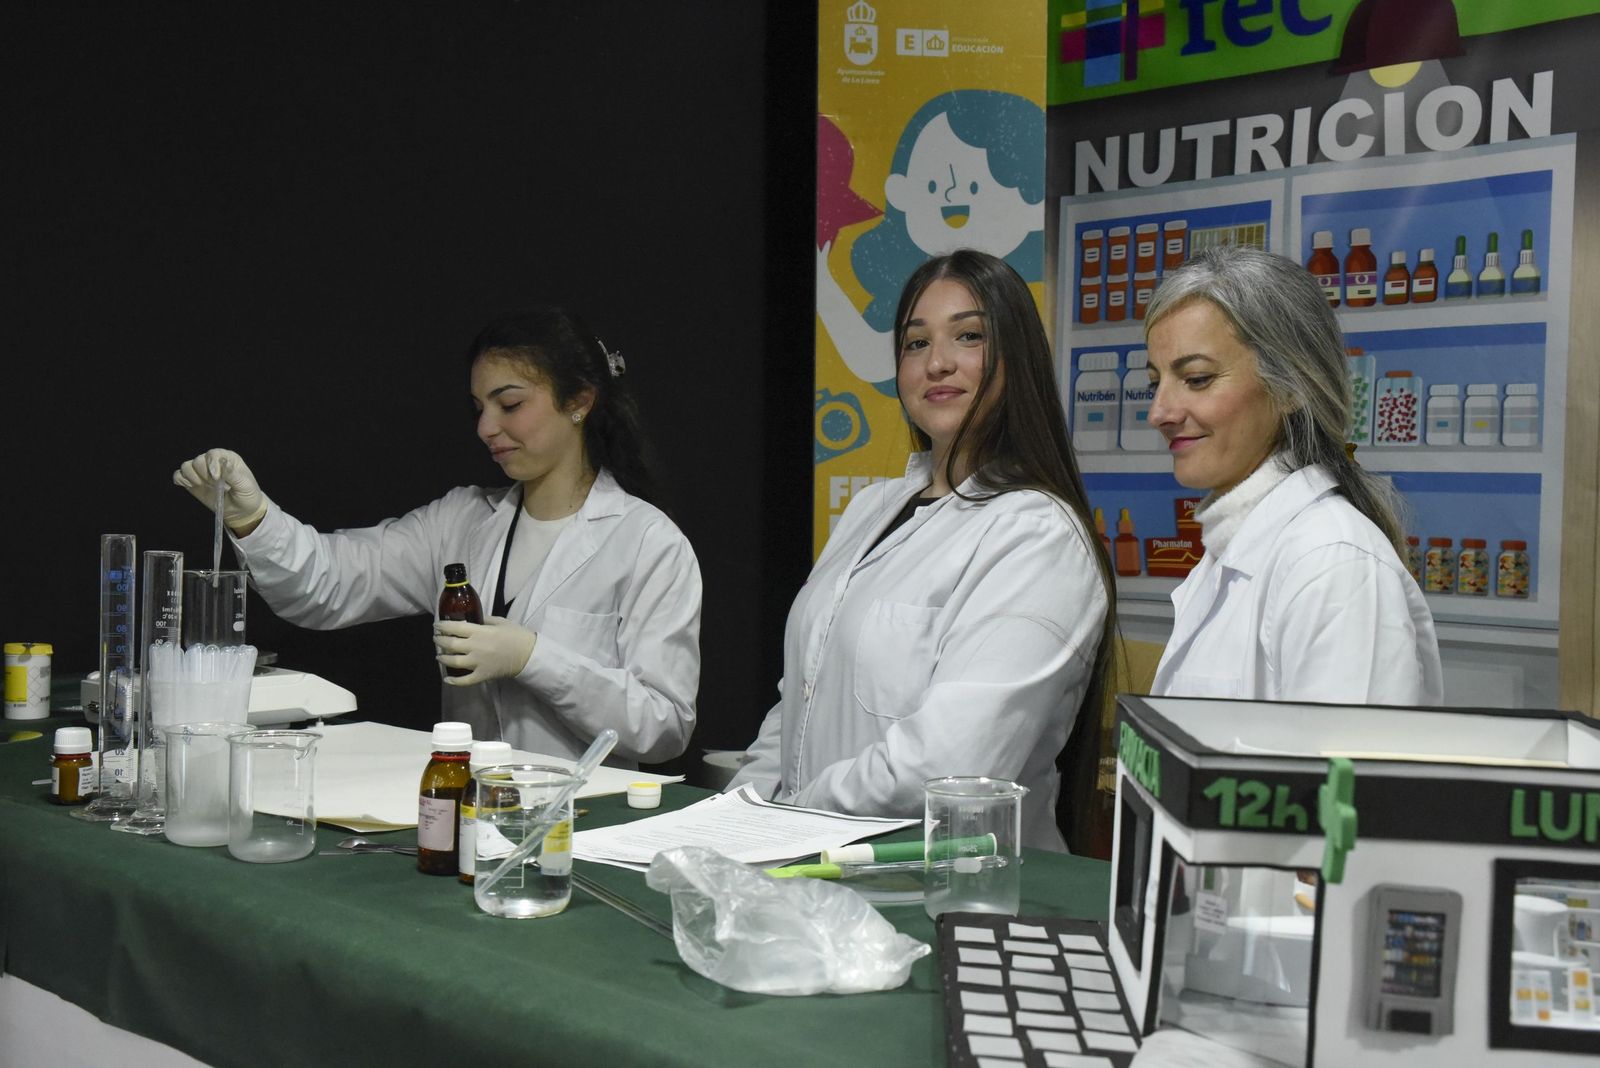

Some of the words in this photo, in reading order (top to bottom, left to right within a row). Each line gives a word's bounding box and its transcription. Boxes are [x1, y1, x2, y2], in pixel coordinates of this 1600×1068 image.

[1073, 70, 1554, 196] NUTRICION
[1077, 391, 1116, 402] Nutribén
[1152, 539, 1193, 549] Pharmaton
[1203, 777, 1308, 832] 12h
